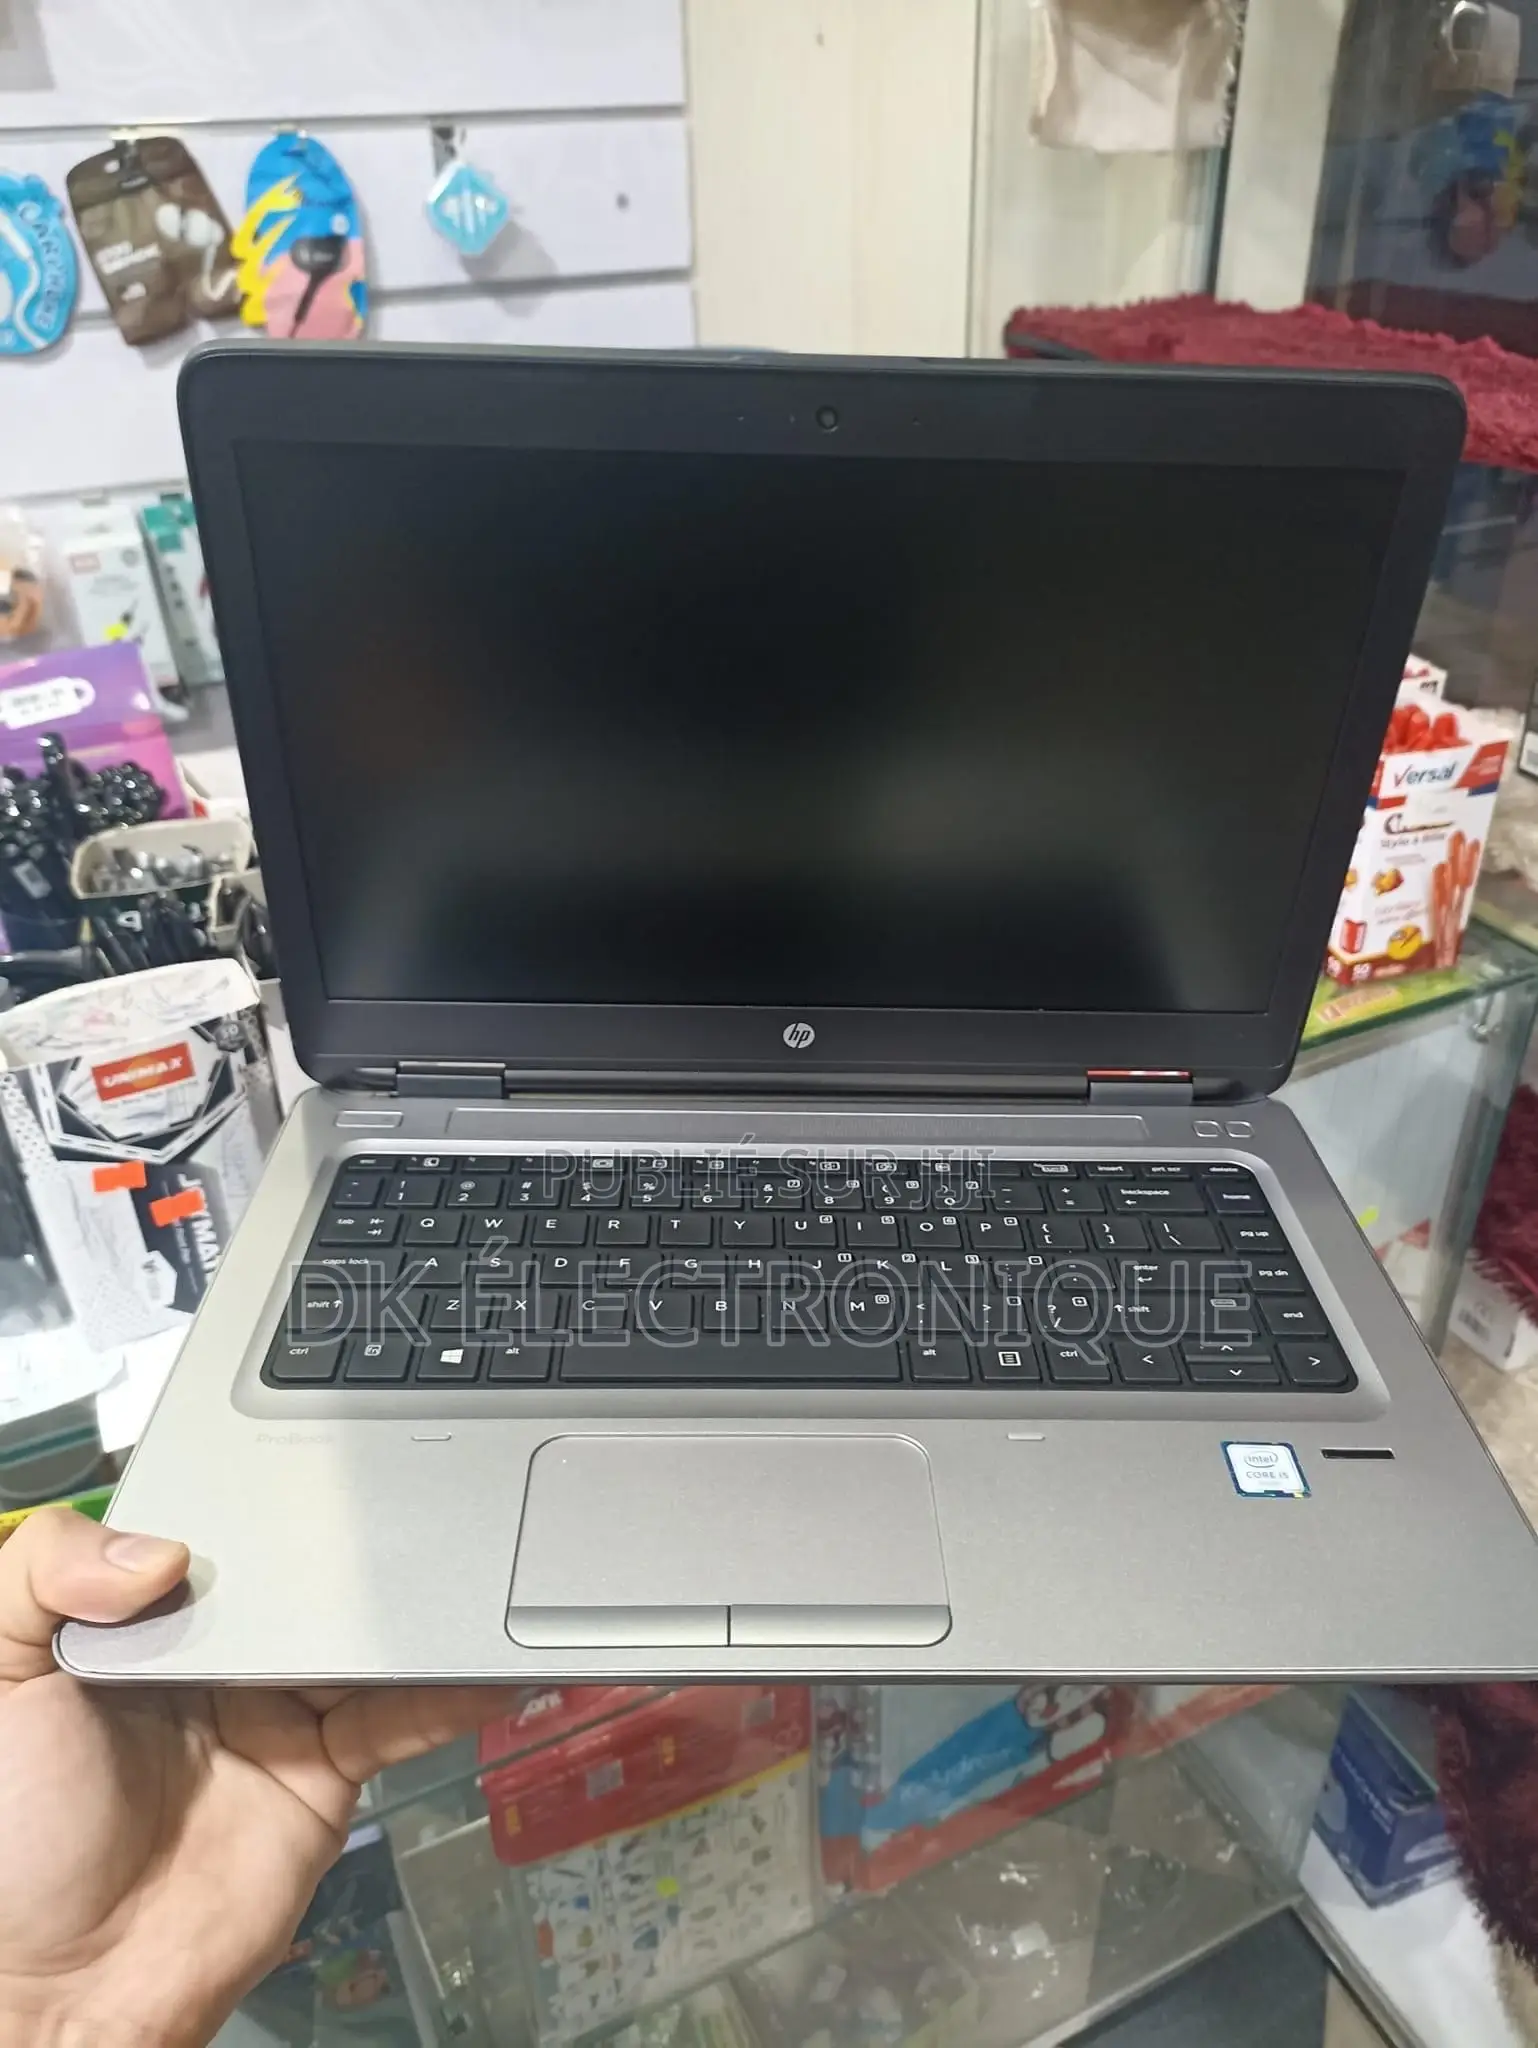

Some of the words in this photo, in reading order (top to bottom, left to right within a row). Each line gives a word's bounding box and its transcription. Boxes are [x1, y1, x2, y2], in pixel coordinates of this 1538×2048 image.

[785, 1022, 814, 1049] hp
[420, 1218, 435, 1228] Q
[484, 1218, 504, 1228] W
[545, 1219, 557, 1229] E
[608, 1219, 620, 1229] R
[670, 1219, 681, 1229] T
[734, 1220, 746, 1230] Y
[794, 1220, 807, 1231] U
[919, 1222, 934, 1232] O
[980, 1222, 992, 1232] P
[321, 1257, 347, 1267] caps
[348, 1257, 370, 1267] lock
[424, 1257, 438, 1268] A
[489, 1257, 501, 1268] S
[554, 1257, 568, 1268] D
[619, 1258, 631, 1268] F
[684, 1259, 698, 1269] G
[748, 1259, 761, 1269] H
[811, 1259, 822, 1270] J
[876, 1259, 890, 1270] K
[940, 1261, 953, 1271] L
[1132, 1263, 1158, 1272] enter
[307, 1300, 330, 1309] shift
[446, 1299, 460, 1311] Z
[514, 1299, 527, 1311] X
[582, 1299, 595, 1311] C
[648, 1299, 663, 1311] V
[715, 1300, 728, 1312] B
[782, 1300, 796, 1311] N
[850, 1301, 865, 1312] M
[1283, 1310, 1304, 1319] end
[289, 1346, 309, 1356] ctrl
[505, 1346, 520, 1356] alt
[922, 1347, 937, 1357] alt
[1059, 1349, 1078, 1359] ctrl
[1245, 1470, 1277, 1479] CORE
